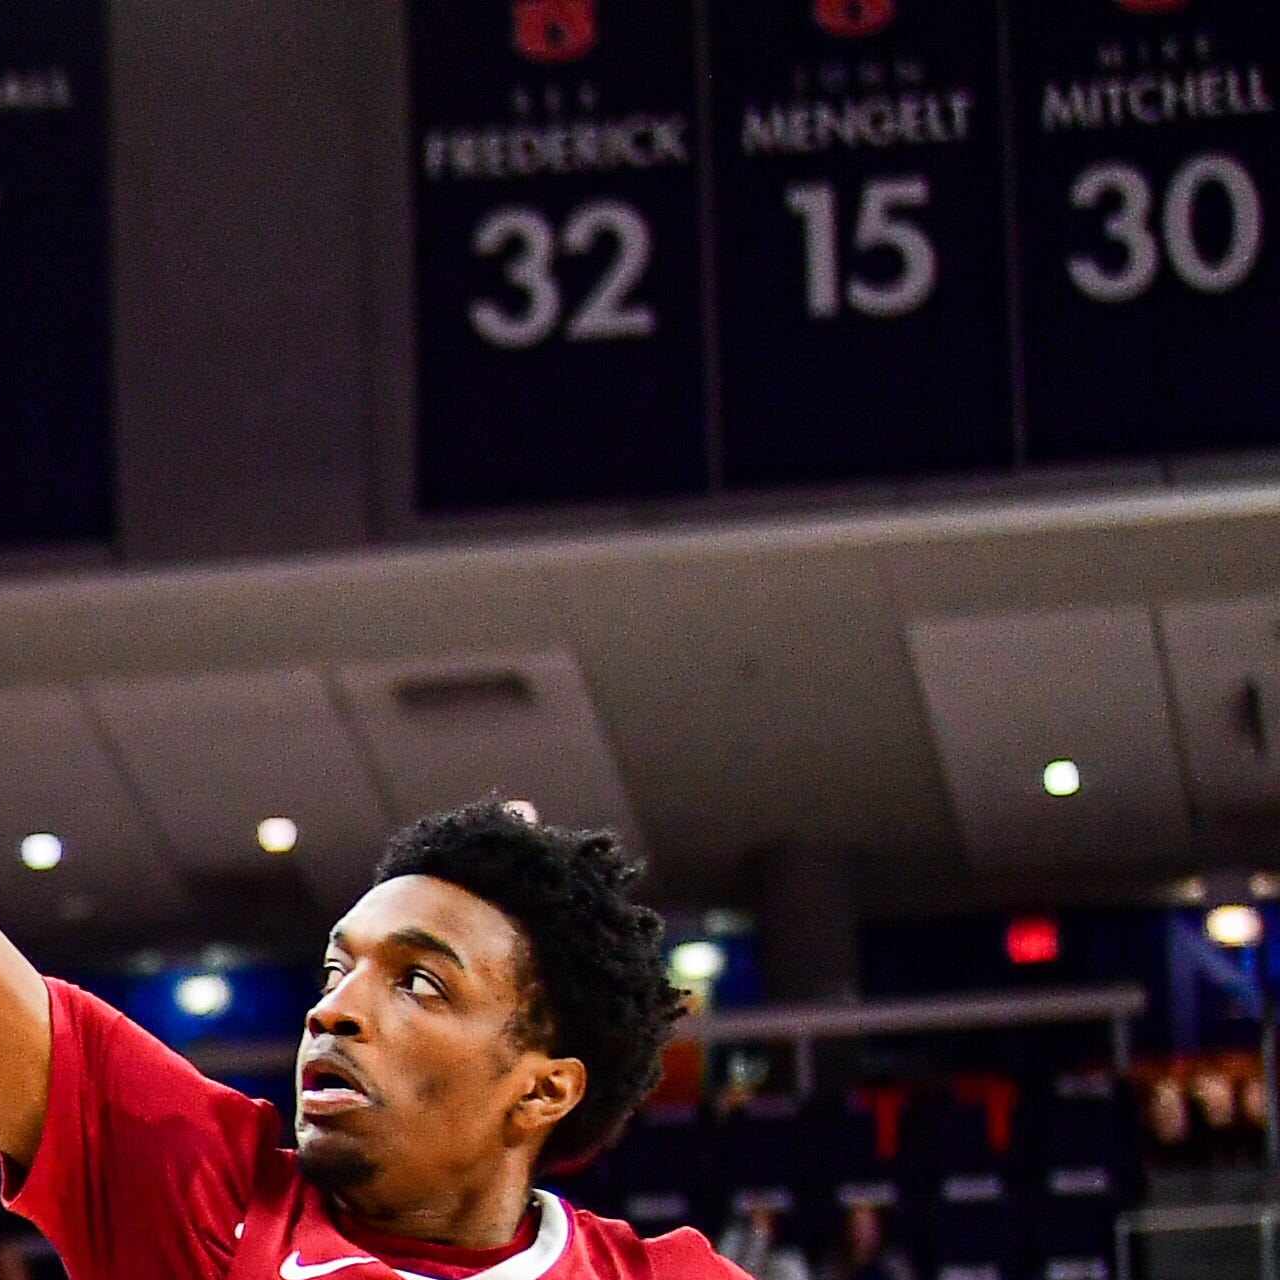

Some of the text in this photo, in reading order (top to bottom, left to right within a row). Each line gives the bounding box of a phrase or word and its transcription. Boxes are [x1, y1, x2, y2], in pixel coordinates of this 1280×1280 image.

[424, 112, 688, 180] FREDERICK
[741, 88, 974, 156] MENGELT
[1041, 62, 1274, 131] MITCHELL
[469, 199, 654, 350] 32
[786, 174, 937, 319] 15
[1067, 153, 1261, 304] 30
